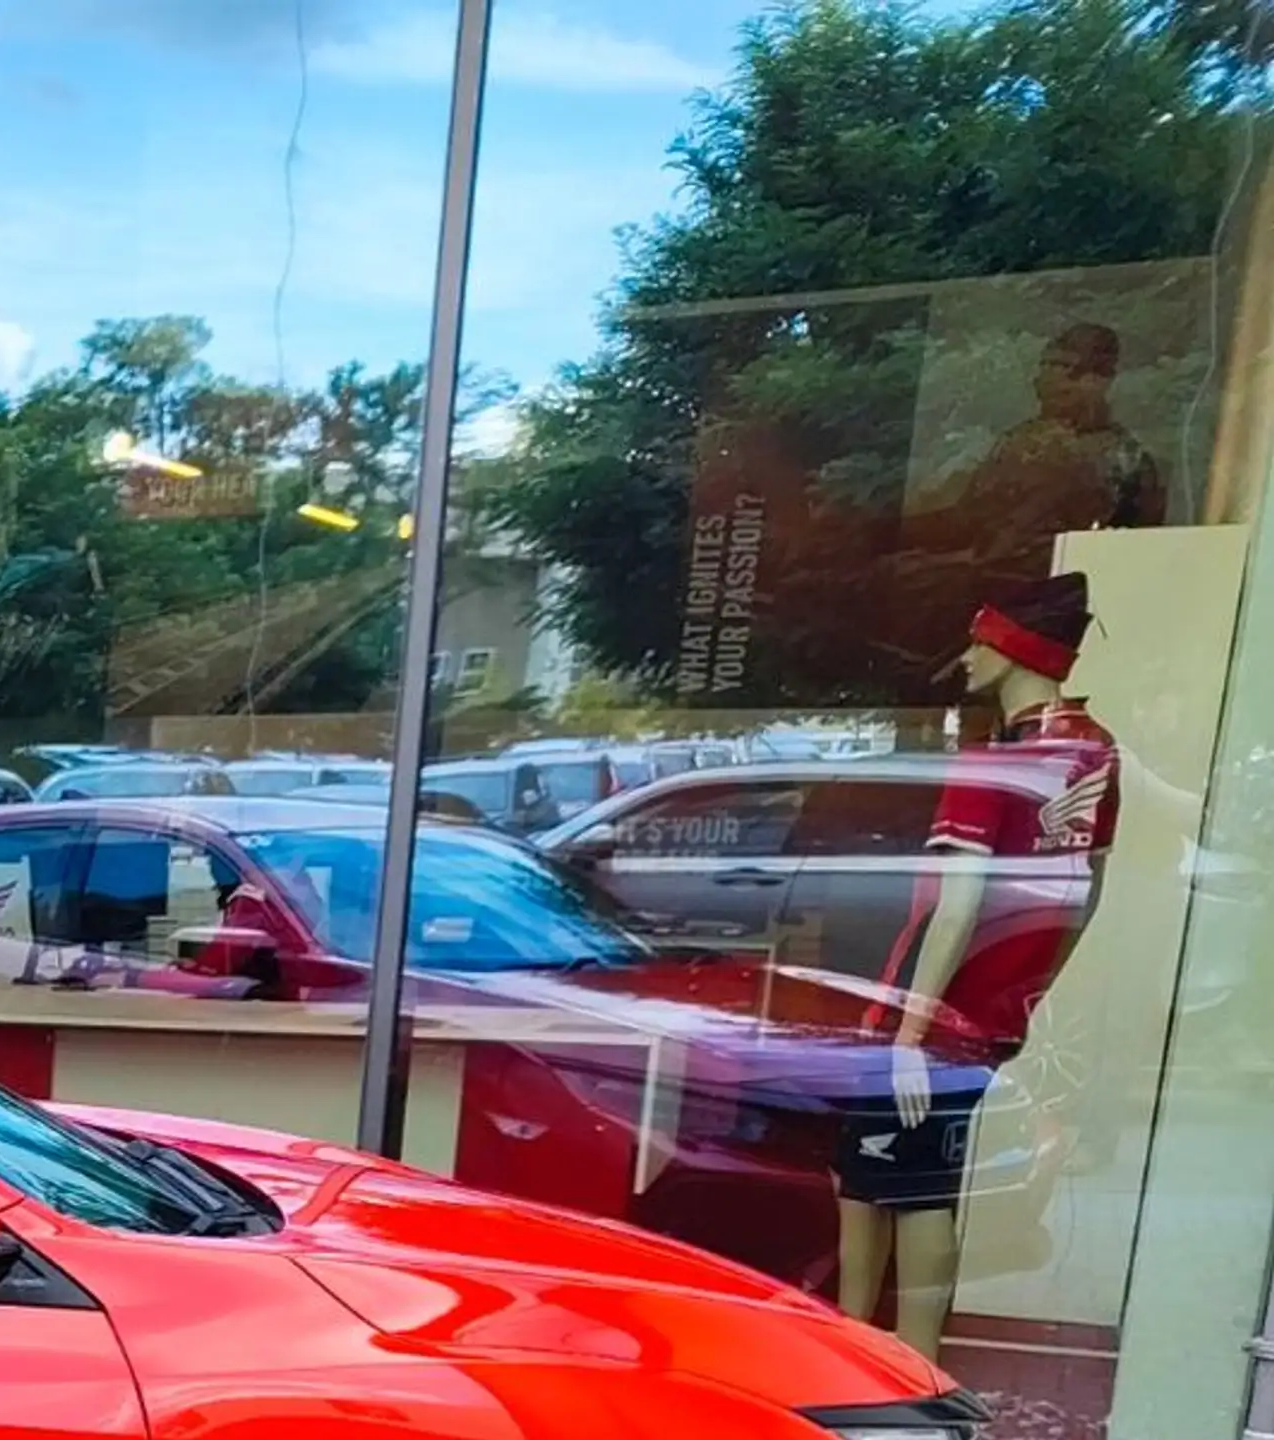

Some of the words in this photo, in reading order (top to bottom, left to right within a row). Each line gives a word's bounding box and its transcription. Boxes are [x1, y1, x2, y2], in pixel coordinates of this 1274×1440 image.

[686, 514, 726, 614] IGNITES
[721, 493, 767, 618] PASSION?
[676, 621, 712, 692] WHAT
[711, 626, 751, 692] YOUR
[670, 815, 740, 844] YOUR
